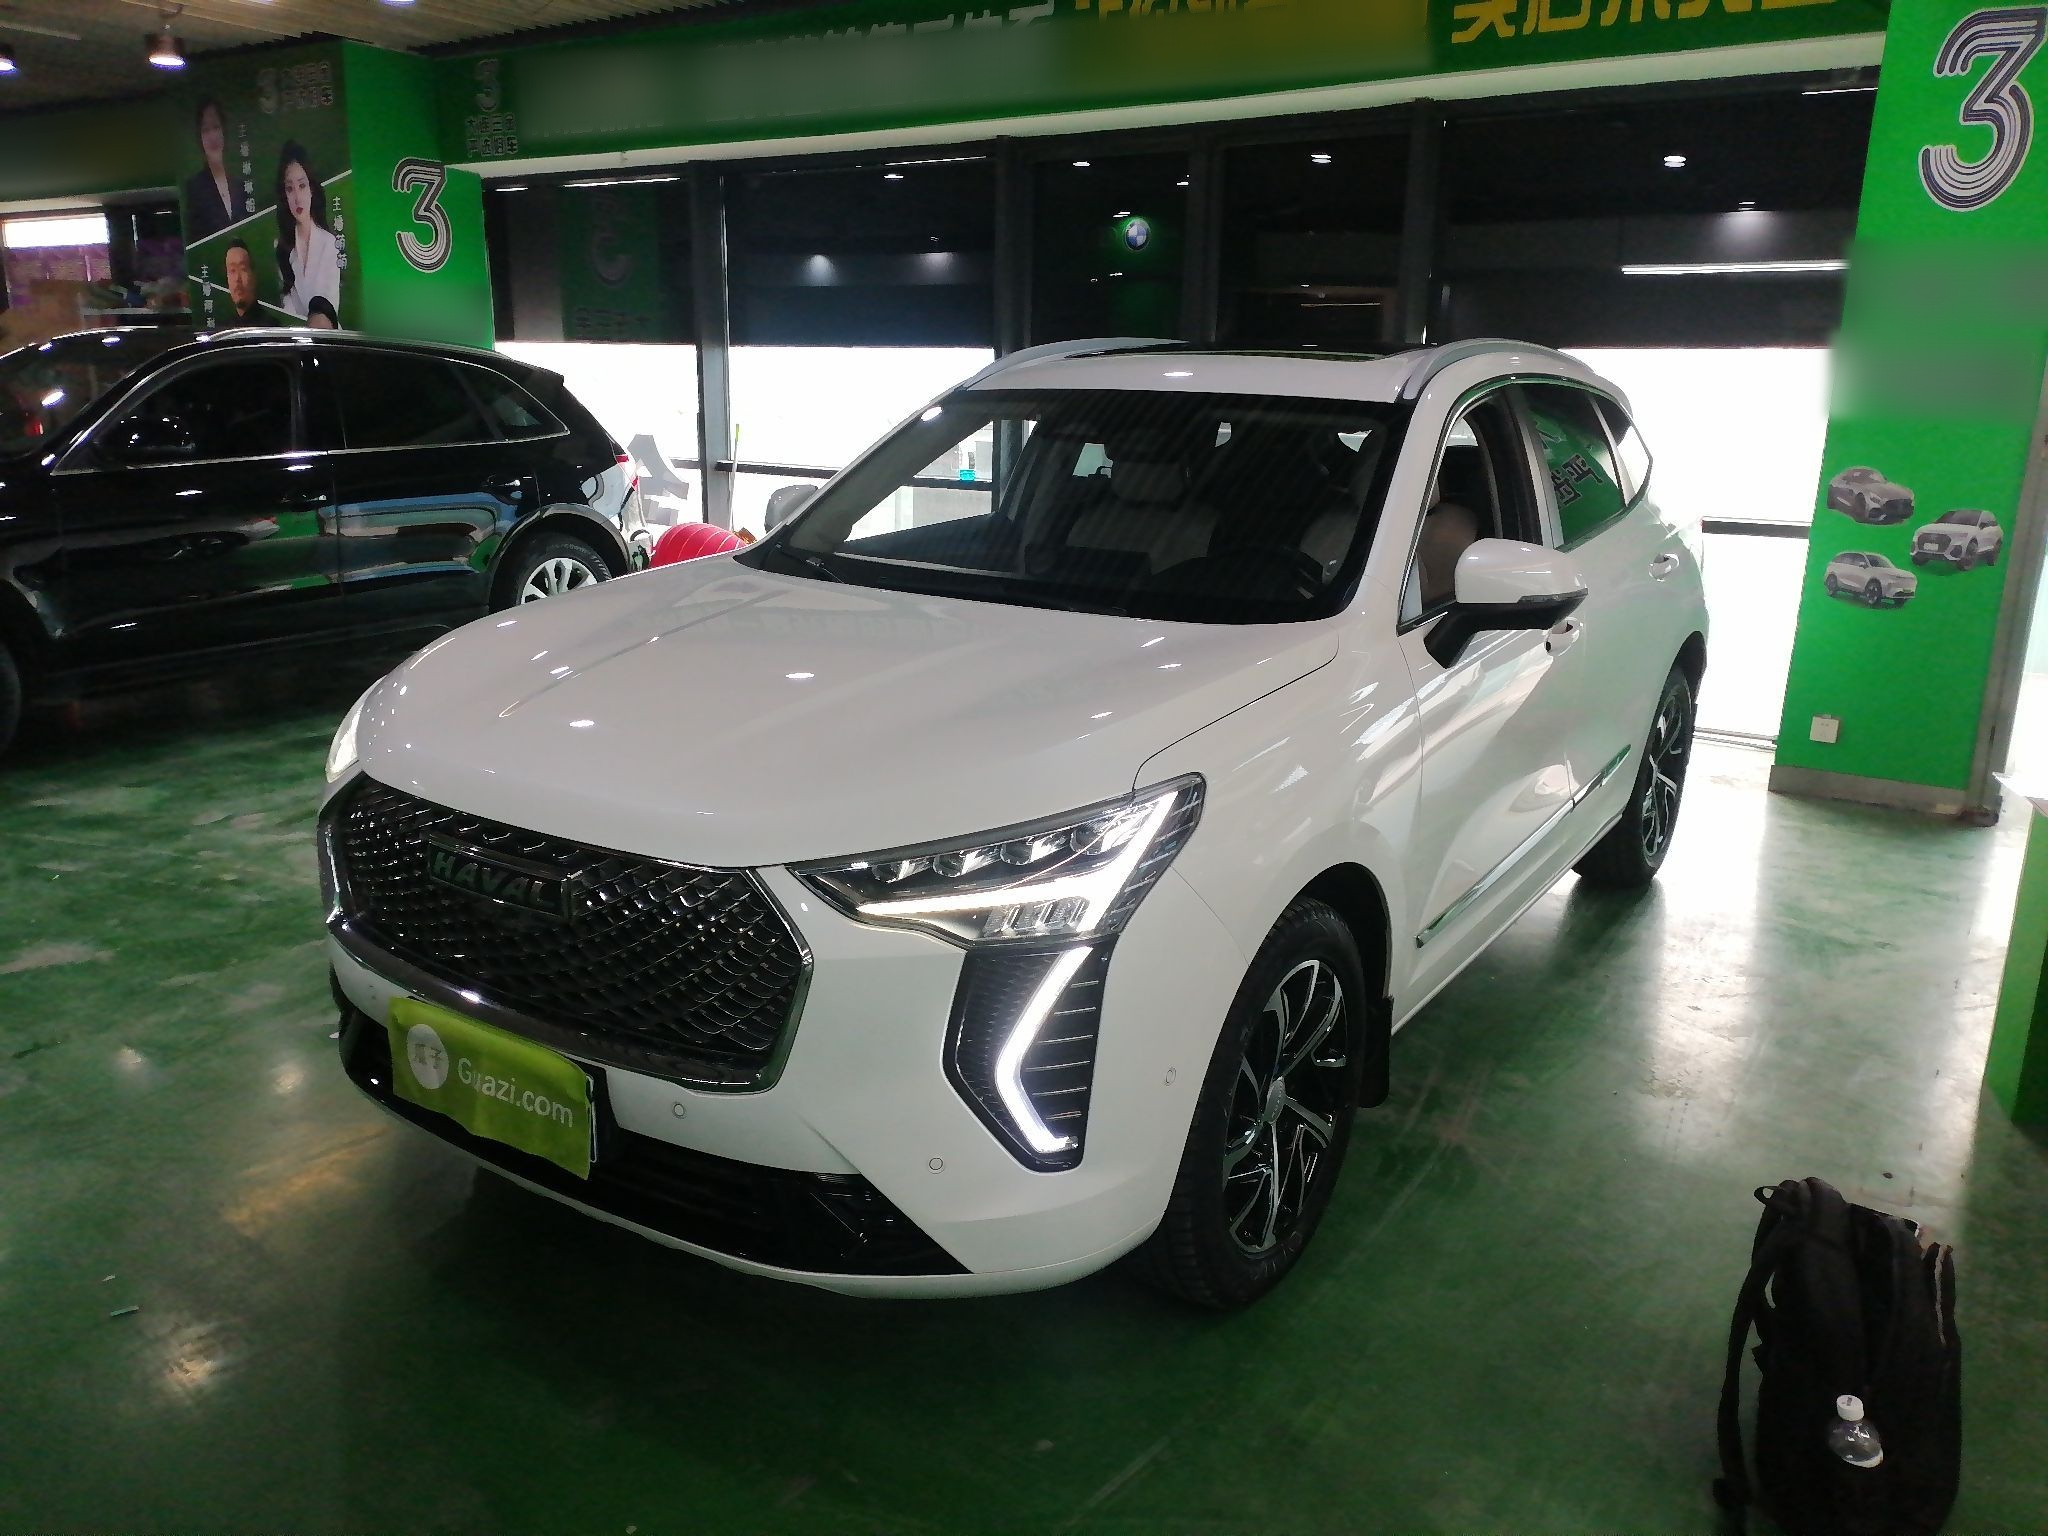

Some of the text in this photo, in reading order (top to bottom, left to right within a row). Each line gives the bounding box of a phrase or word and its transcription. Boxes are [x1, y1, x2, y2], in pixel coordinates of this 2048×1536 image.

[1918, 4, 2048, 213] 3
[392, 157, 452, 273] 3
[433, 851, 555, 909] HAVAL
[458, 1057, 573, 1128] Guazi.com
